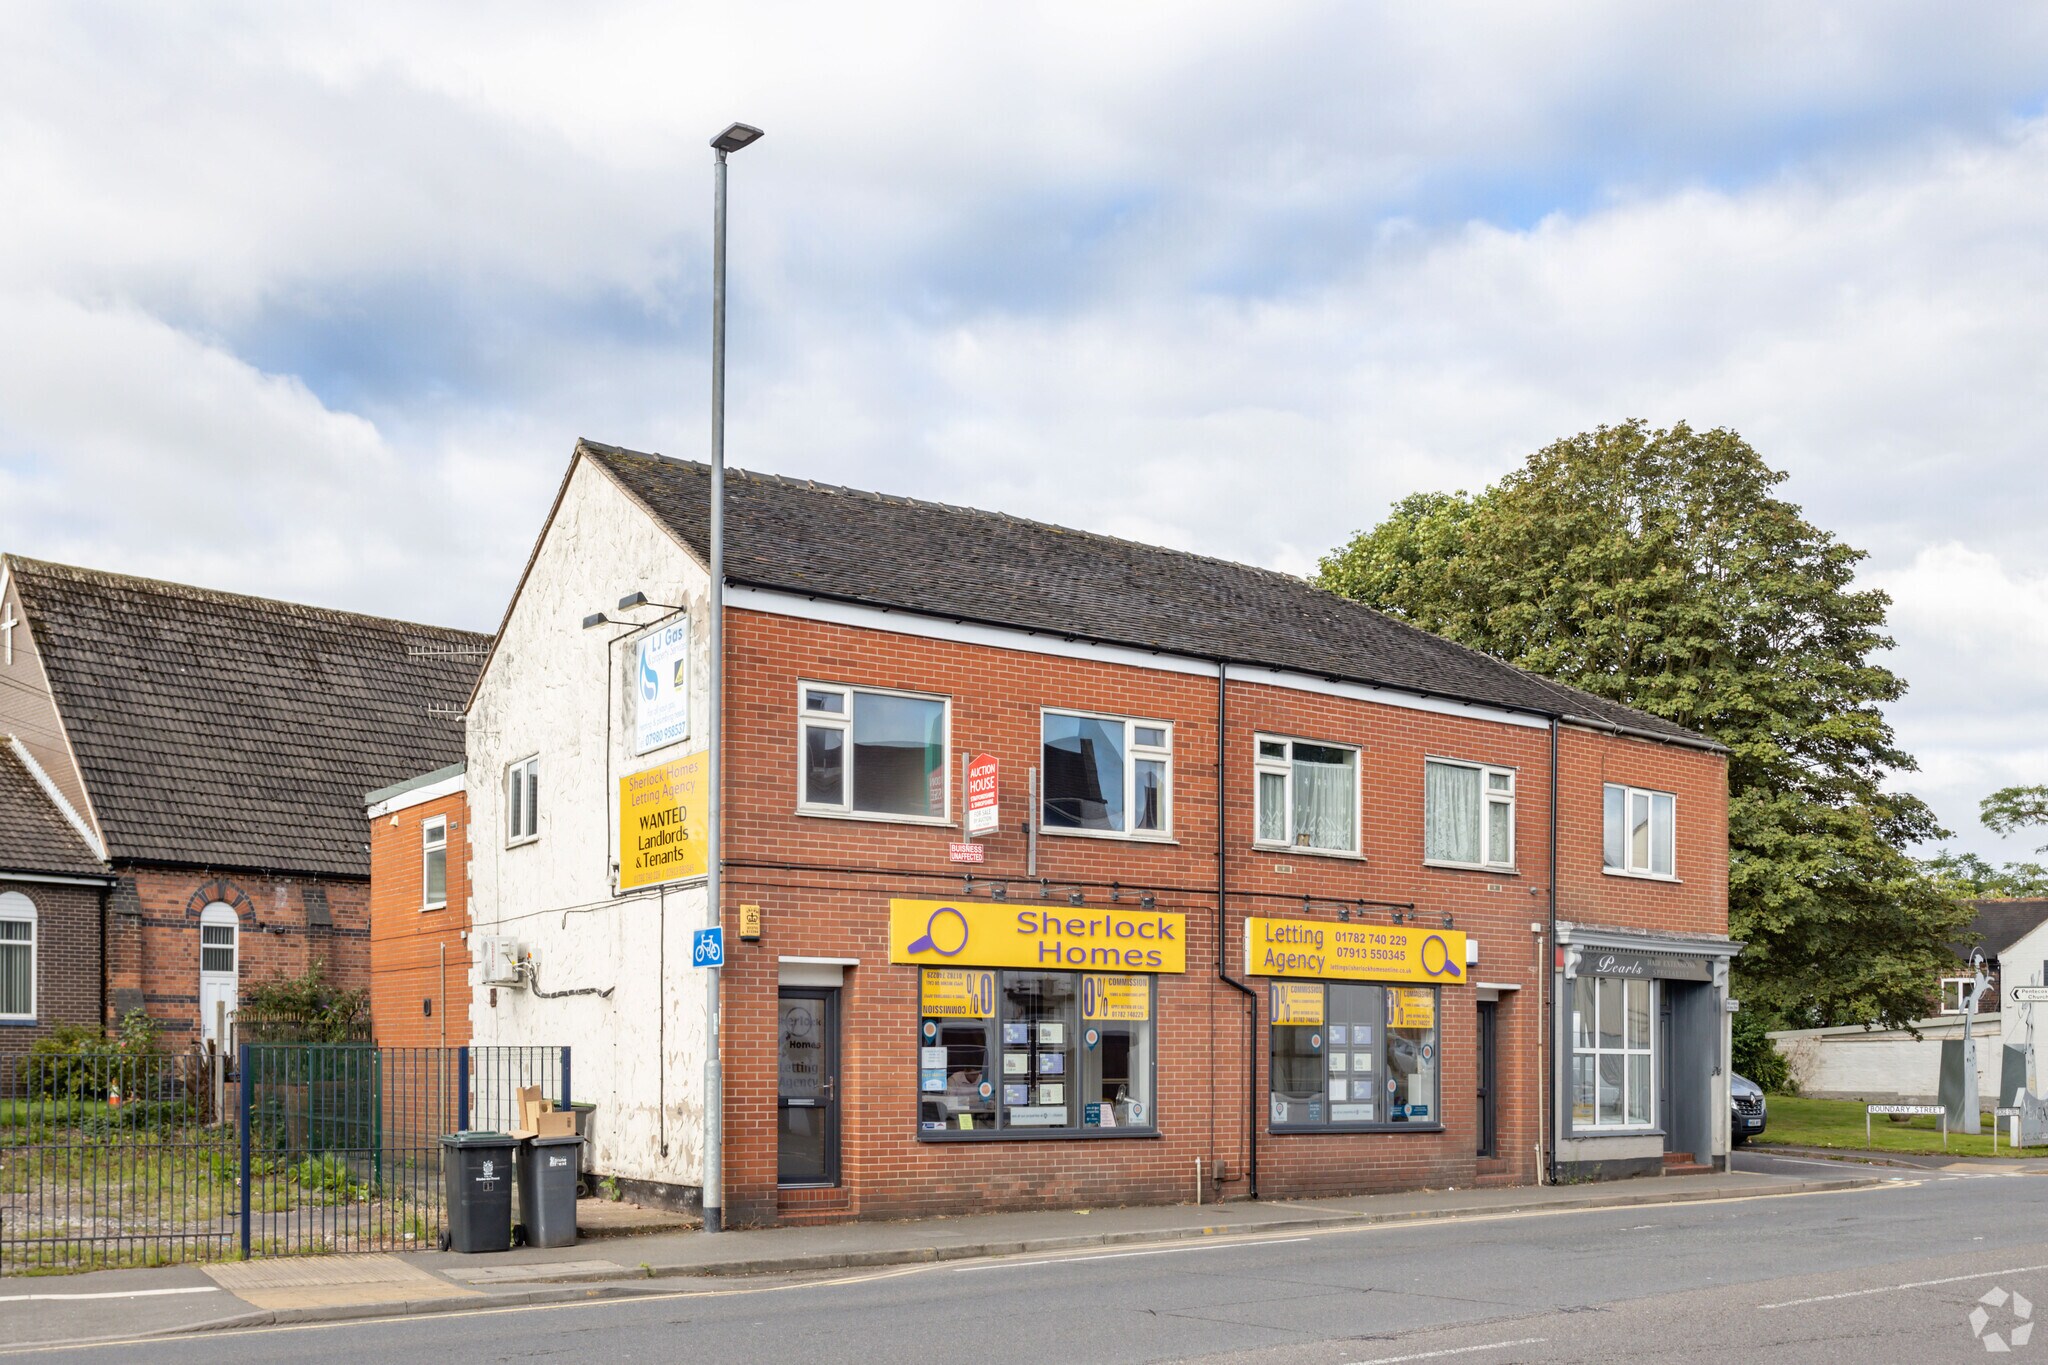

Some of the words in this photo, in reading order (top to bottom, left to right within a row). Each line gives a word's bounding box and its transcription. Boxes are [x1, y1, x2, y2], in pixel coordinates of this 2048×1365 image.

[665, 628, 683, 646] Gas
[645, 730, 663, 746] 07980
[628, 768, 665, 792] Sherlock
[666, 762, 699, 780] Homes
[970, 763, 996, 779] AUCTION
[969, 776, 995, 793] HOUSE
[631, 789, 660, 807] Letting
[662, 780, 696, 801] Agency
[639, 805, 687, 831] WANTED
[638, 825, 689, 851] Landlords
[635, 856, 642, 869] &
[643, 846, 684, 868] Tenants
[951, 853, 982, 862] UNAFFECTED
[1017, 911, 1175, 940] Sherlock
[1265, 922, 1324, 950] Letting
[1335, 931, 1366, 944] 01782
[1368, 933, 1387, 945] 740
[1389, 935, 1407, 946] 229
[1039, 940, 1162, 967] Homes
[1263, 947, 1326, 974] Agency
[1336, 946, 1367, 959] 07913
[1370, 949, 1406, 961] 550345
[1596, 954, 1644, 975] Pearls
[1108, 978, 1147, 987] COMMISSION
[1291, 985, 1323, 994] COMMISSION
[922, 1005, 967, 1015] COMMISSION
[789, 1040, 822, 1049] Homes
[780, 1061, 818, 1074] Letting
[779, 1077, 818, 1089] Agency
[1870, 1105, 1911, 1113] BOUNDARY
[1914, 1105, 1943, 1113] STREET
